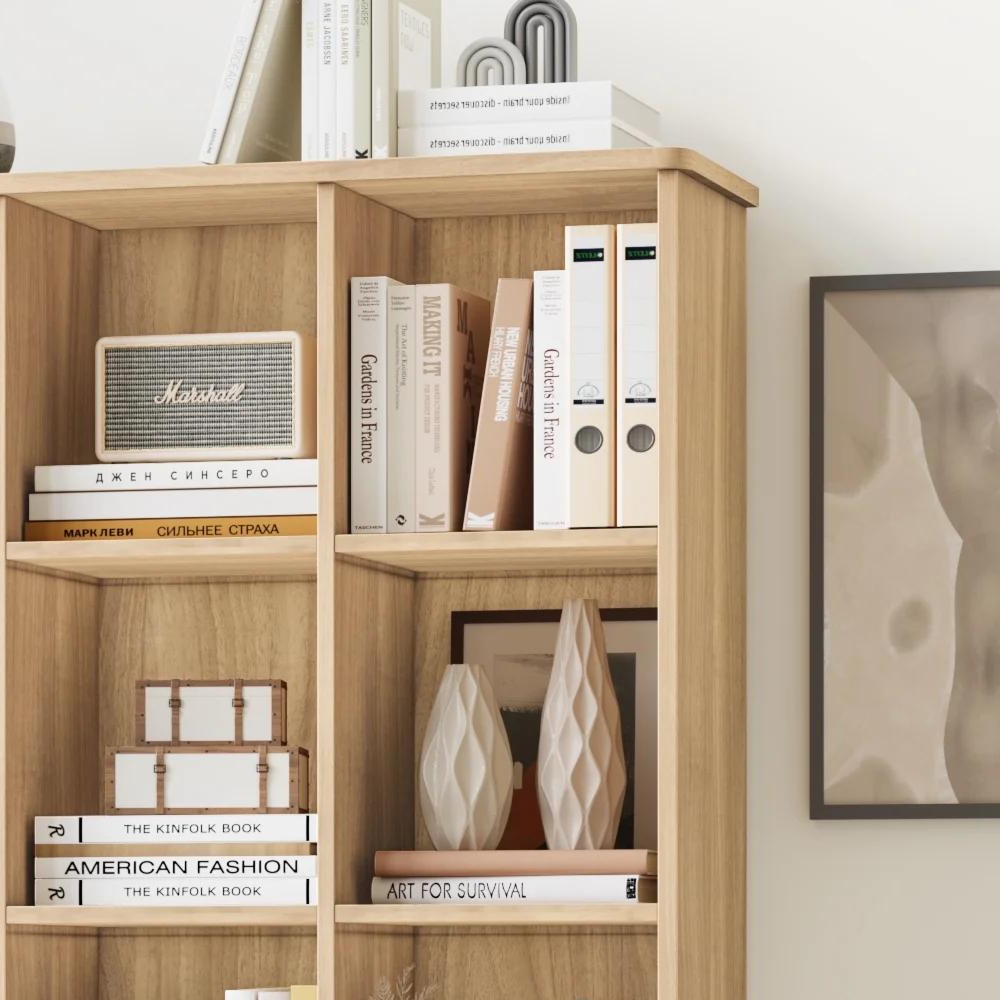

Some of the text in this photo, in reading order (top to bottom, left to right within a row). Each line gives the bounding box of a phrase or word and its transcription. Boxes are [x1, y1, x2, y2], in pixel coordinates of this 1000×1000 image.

[323, 2, 331, 65] ARNE JACOBSEN
[341, 26, 349, 65] SAARINEN
[422, 296, 442, 376] MAKING IT
[494, 327, 520, 422] NEW URBAN HOUSING
[154, 378, 246, 405] Marshall
[360, 354, 378, 464] Gardens in France
[544, 348, 560, 459] Gardens in France
[96, 469, 270, 485] ДЖЕН СИНСЕРО
[63, 527, 134, 538] МАРК ЛЕВИ
[157, 524, 280, 538] СИЛЬНЕЕ СТРАХА
[124, 823, 262, 834] THE KINFOLK BOOK
[64, 859, 299, 875] AMERICAN FASHION
[124, 886, 262, 897] THE KINFOLK BOOK
[386, 882, 527, 900] ART FOR SURVIVAL
